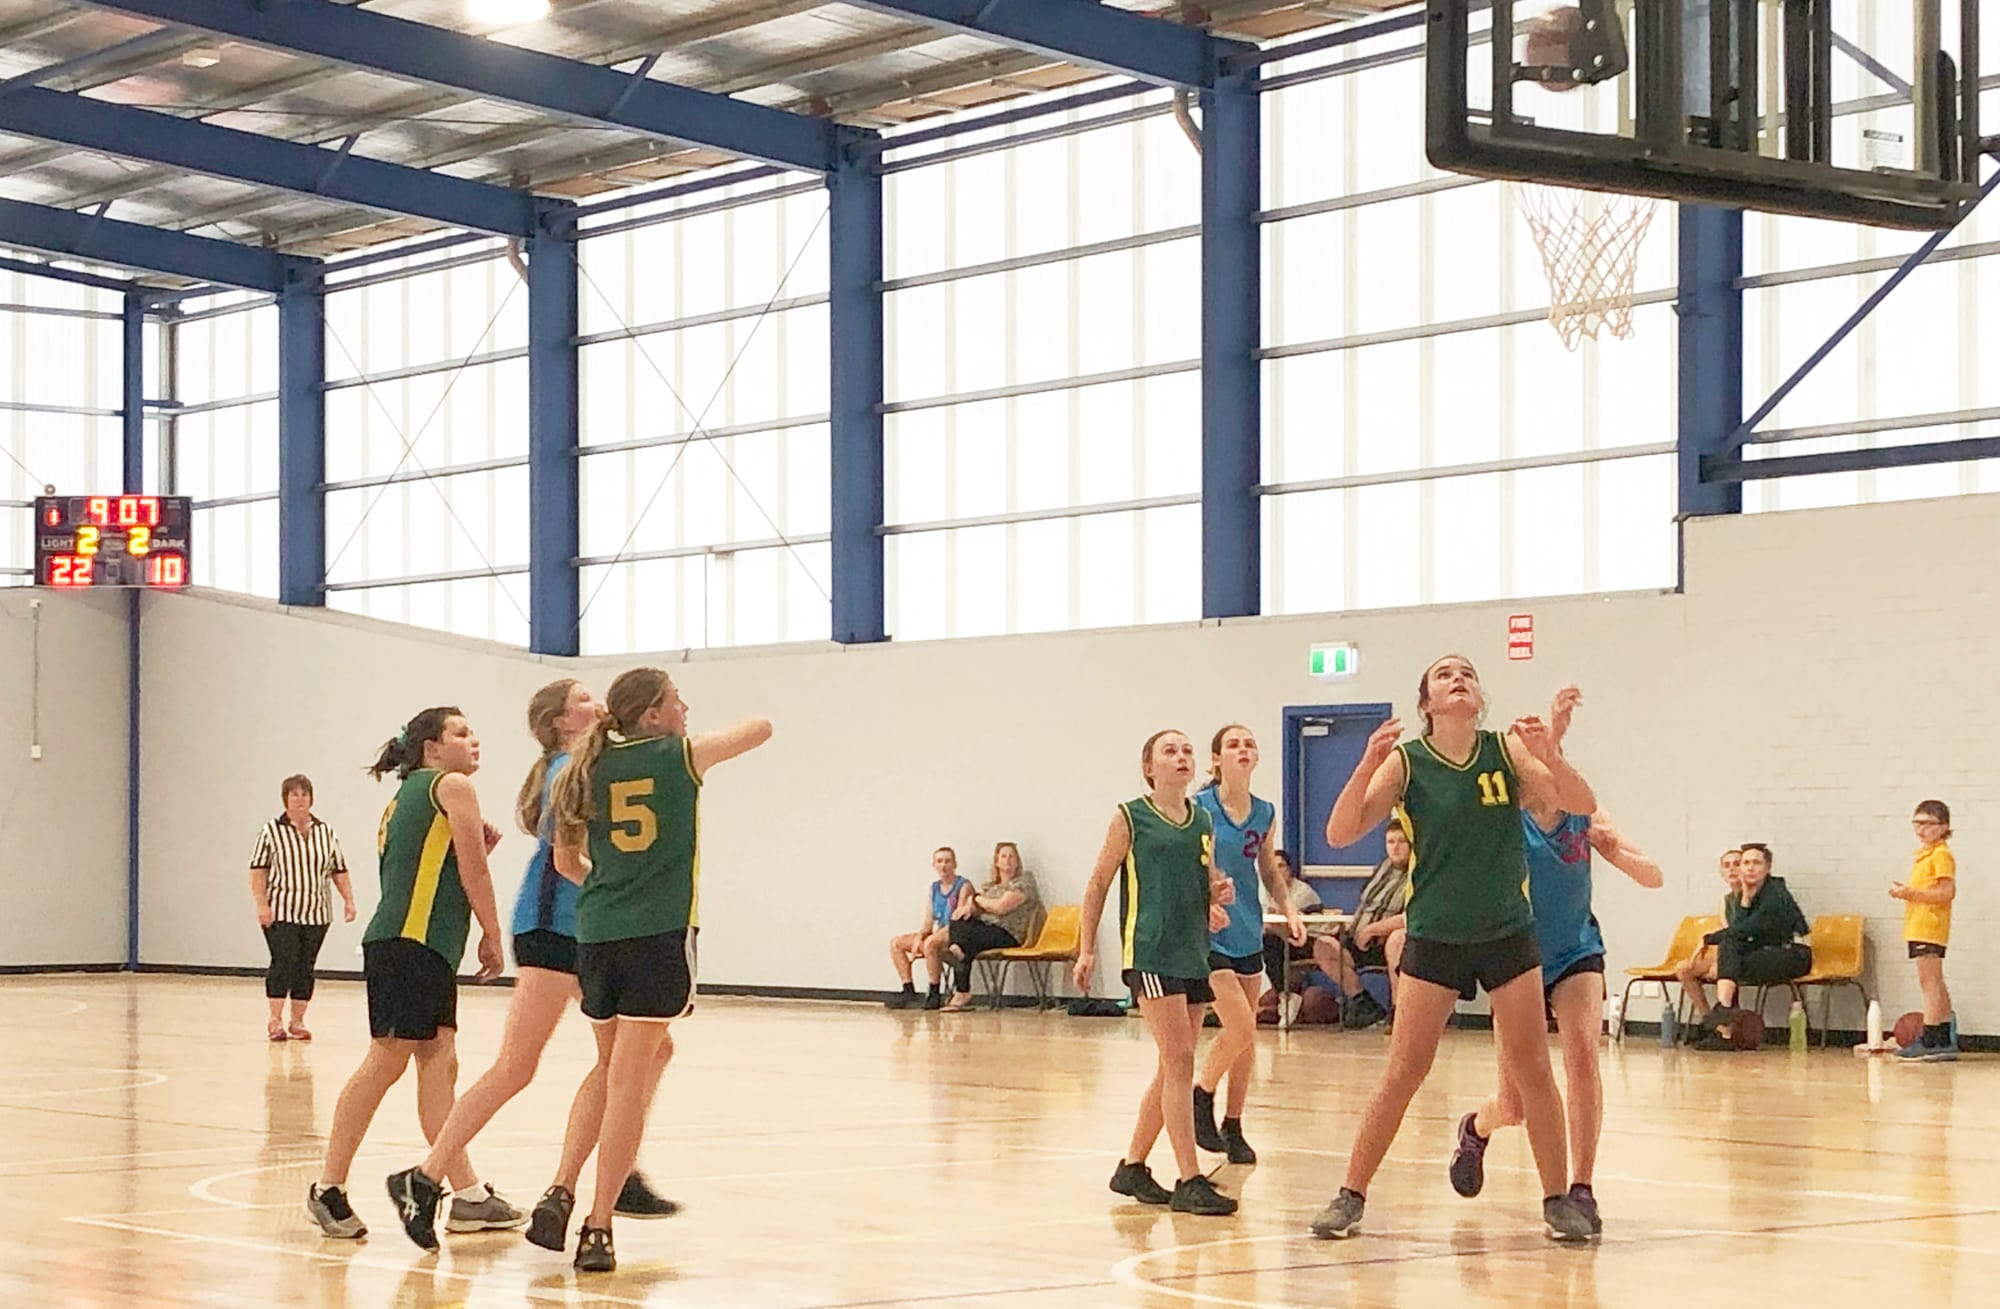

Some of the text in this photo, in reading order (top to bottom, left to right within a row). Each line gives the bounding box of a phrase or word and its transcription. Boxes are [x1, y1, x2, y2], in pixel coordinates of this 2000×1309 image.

[41, 538, 75, 548] LIGHT
[76, 526, 98, 554] 2
[127, 526, 150, 555] 2
[152, 539, 185, 548] DARK
[52, 556, 92, 583] 22
[152, 556, 182, 584] 10
[1477, 770, 1510, 806] 11
[609, 777, 657, 853] 5
